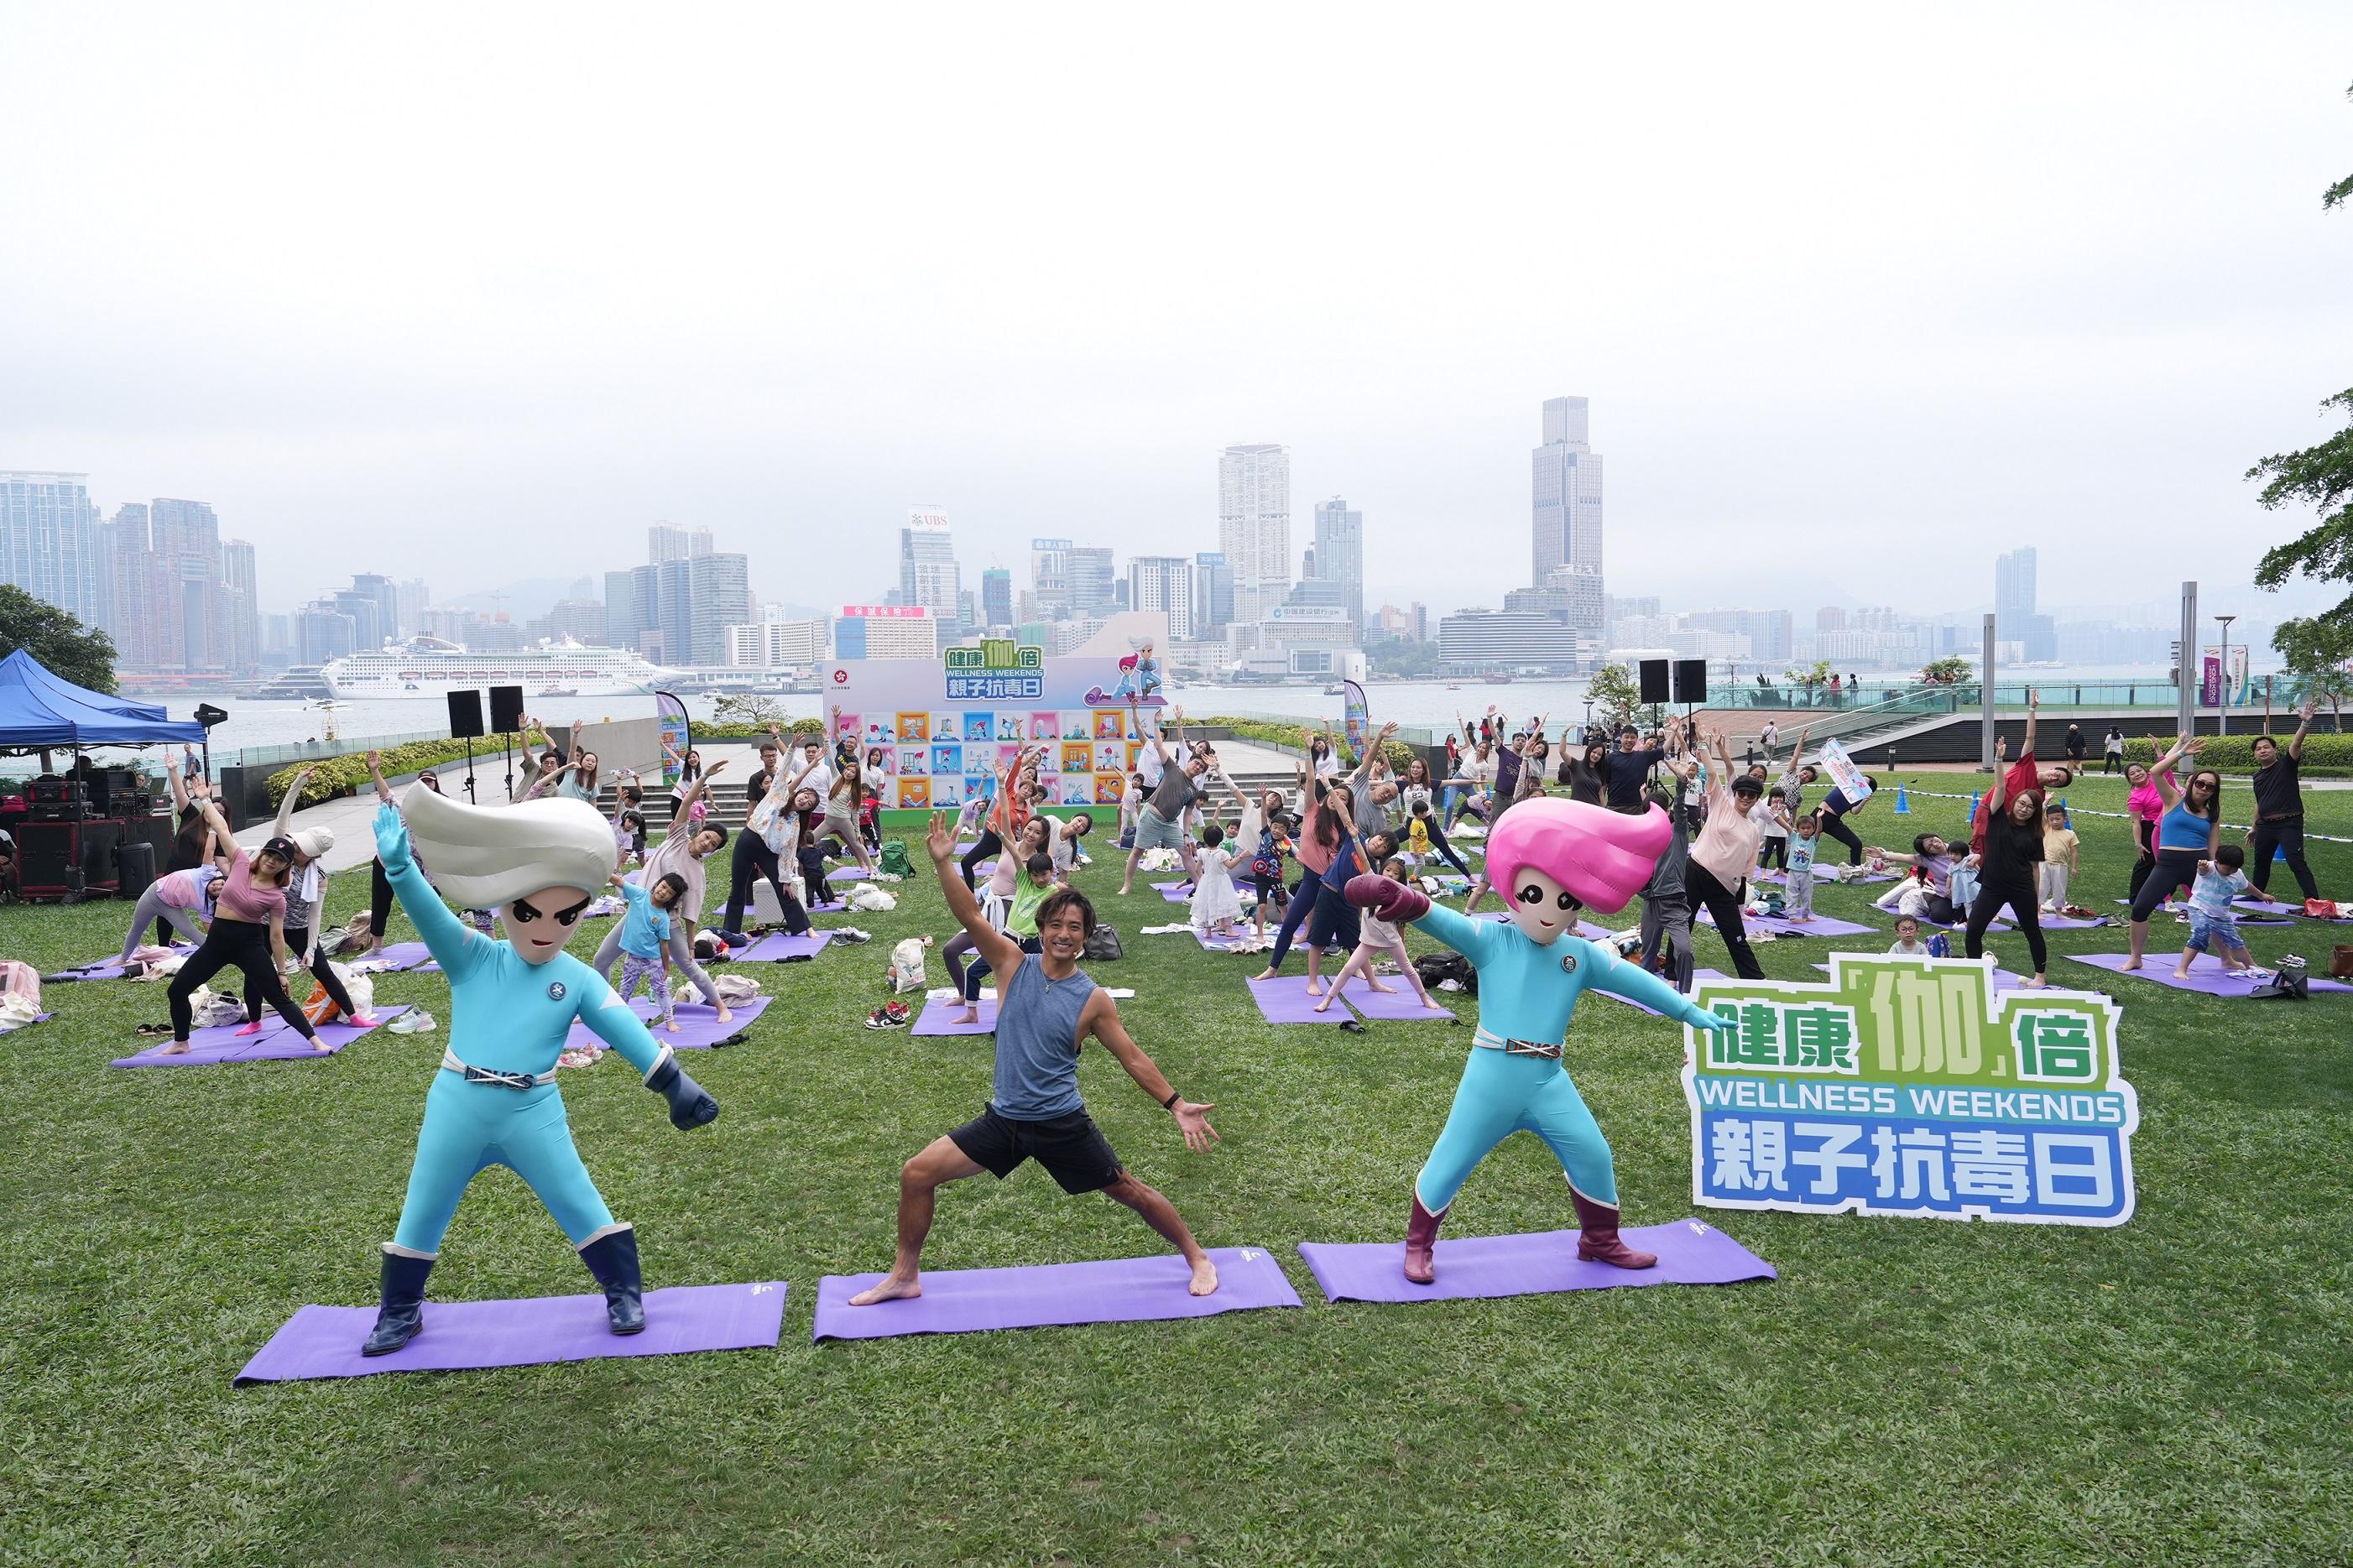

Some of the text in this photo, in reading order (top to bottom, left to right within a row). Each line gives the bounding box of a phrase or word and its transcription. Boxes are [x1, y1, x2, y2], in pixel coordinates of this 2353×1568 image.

[925, 515, 947, 525] UBS
[949, 679, 1041, 696] 親子抗毒日
[1699, 1079, 2121, 1123] WELLNESS WEEKENDS
[1712, 1117, 2115, 1208] 親子抗毒日
